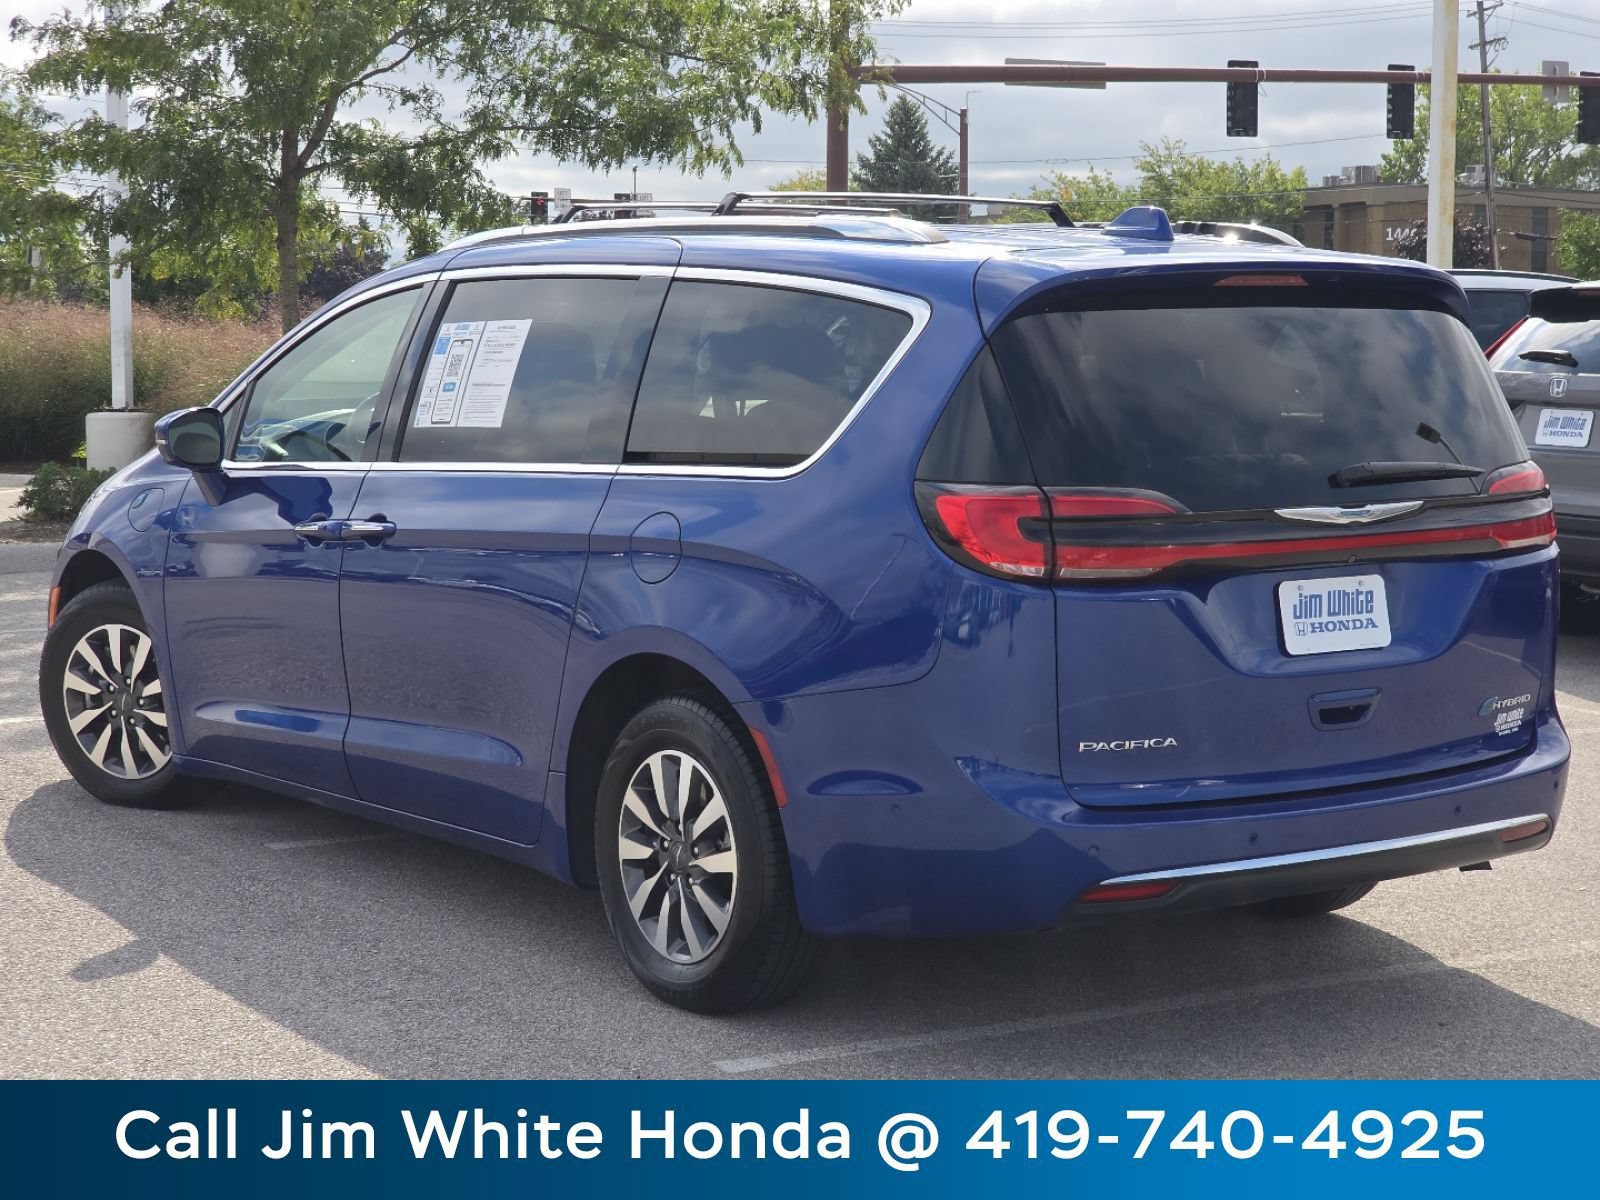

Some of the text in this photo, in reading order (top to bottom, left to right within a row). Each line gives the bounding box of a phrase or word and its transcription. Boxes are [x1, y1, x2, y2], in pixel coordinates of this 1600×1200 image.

[1549, 430, 1583, 438] HONDA
[1293, 588, 1374, 619] Jim White
[1310, 617, 1378, 633] HONDA
[1492, 693, 1531, 710] HYBRID
[1079, 737, 1178, 752] PACIFICA
